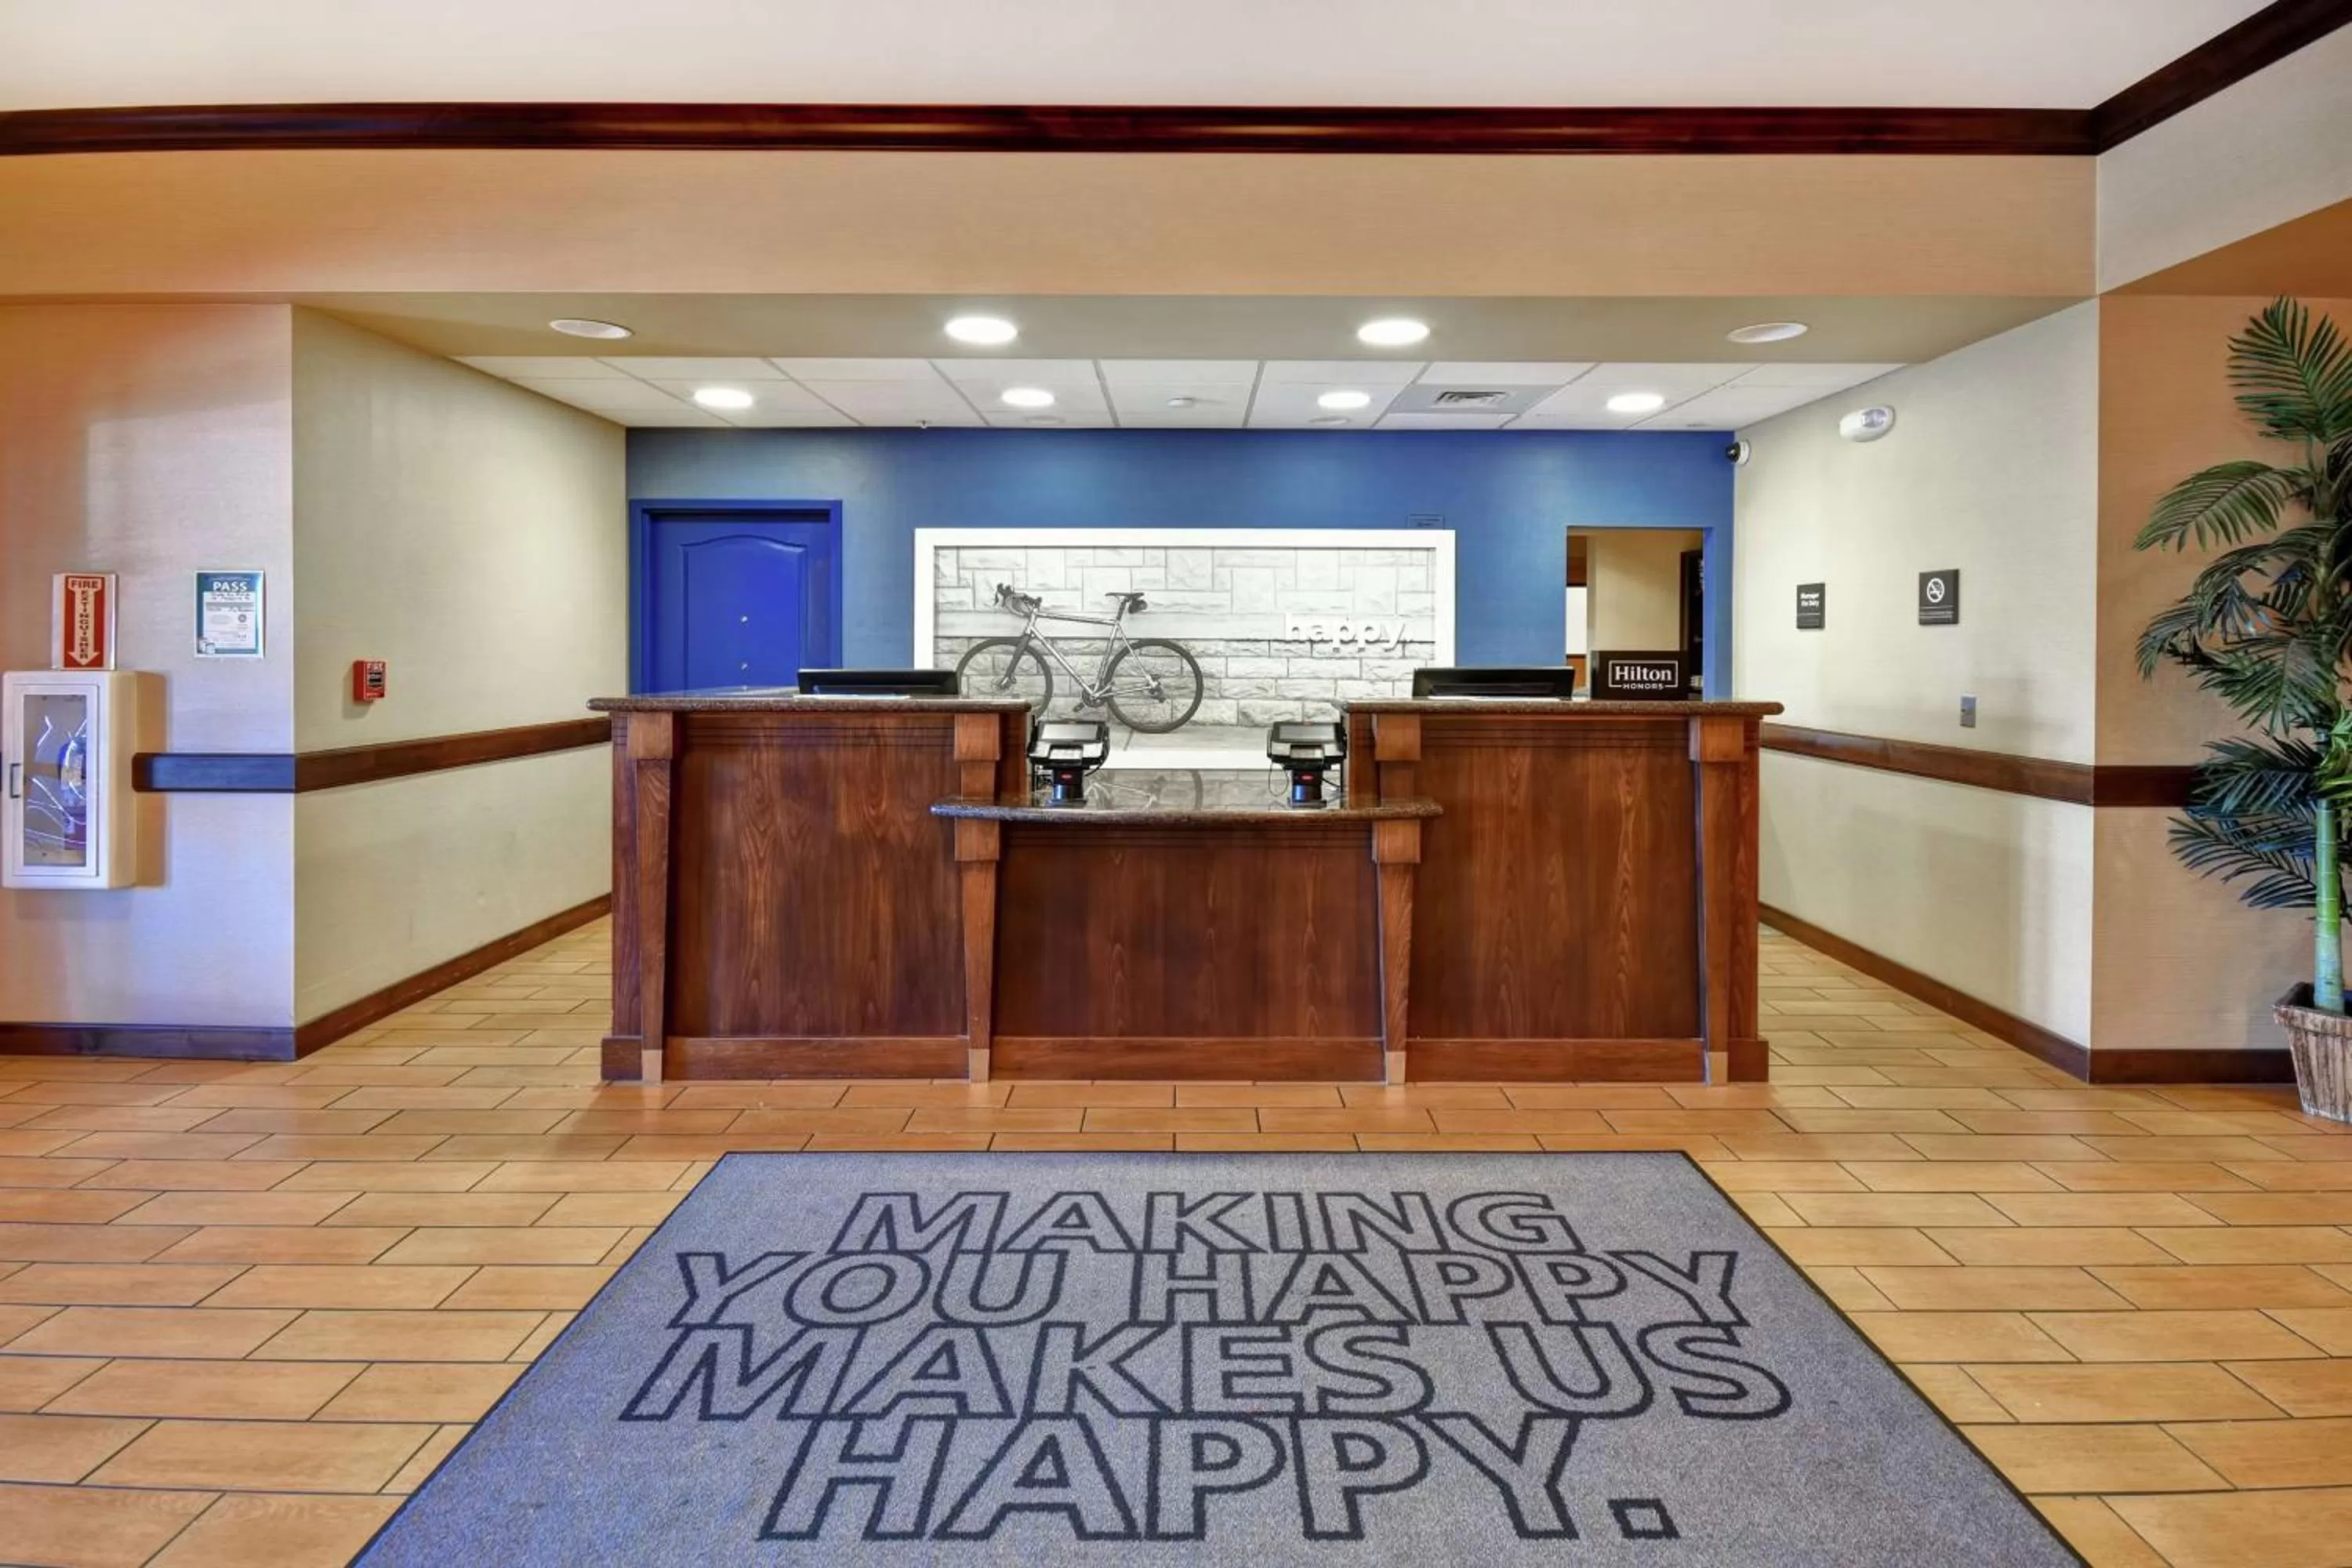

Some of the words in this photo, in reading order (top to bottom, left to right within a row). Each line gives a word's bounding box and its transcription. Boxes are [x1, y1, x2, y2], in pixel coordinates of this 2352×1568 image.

[71, 579, 99, 589] FIRE
[212, 581, 249, 591] PASS
[1615, 666, 1672, 681] Hilton
[827, 1192, 1585, 1254] MAKING
[667, 1251, 1069, 1329] YOU
[1129, 1251, 1751, 1327] HAPPY
[618, 1322, 1436, 1421] MAKES
[1485, 1321, 1793, 1420] US
[756, 1414, 1682, 1541] HAPPY.
